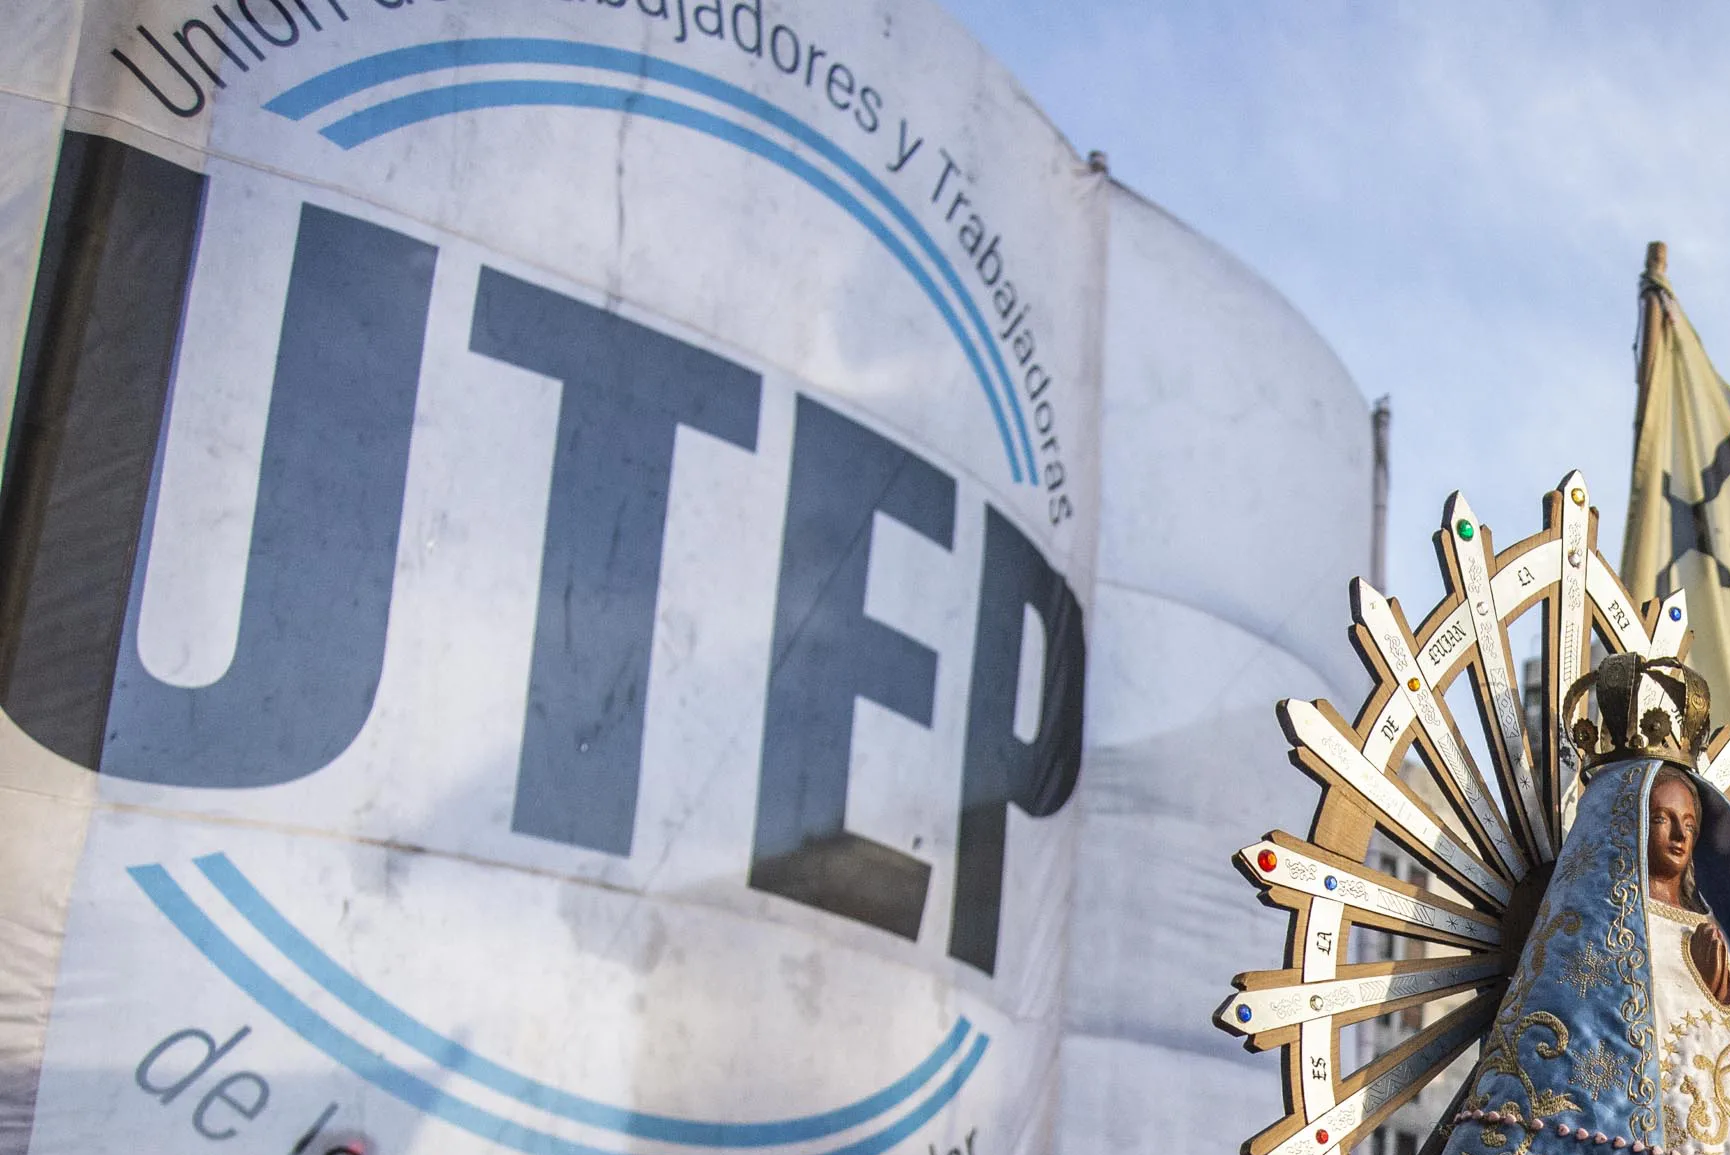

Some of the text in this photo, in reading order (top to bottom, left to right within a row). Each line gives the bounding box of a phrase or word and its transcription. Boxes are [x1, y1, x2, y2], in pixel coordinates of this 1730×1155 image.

[886, 118, 923, 173] y
[928, 146, 1074, 526] Trabajadoras
[0, 128, 1087, 978] UTEP
[1380, 714, 1400, 745] DE
[135, 1025, 271, 1140] de
